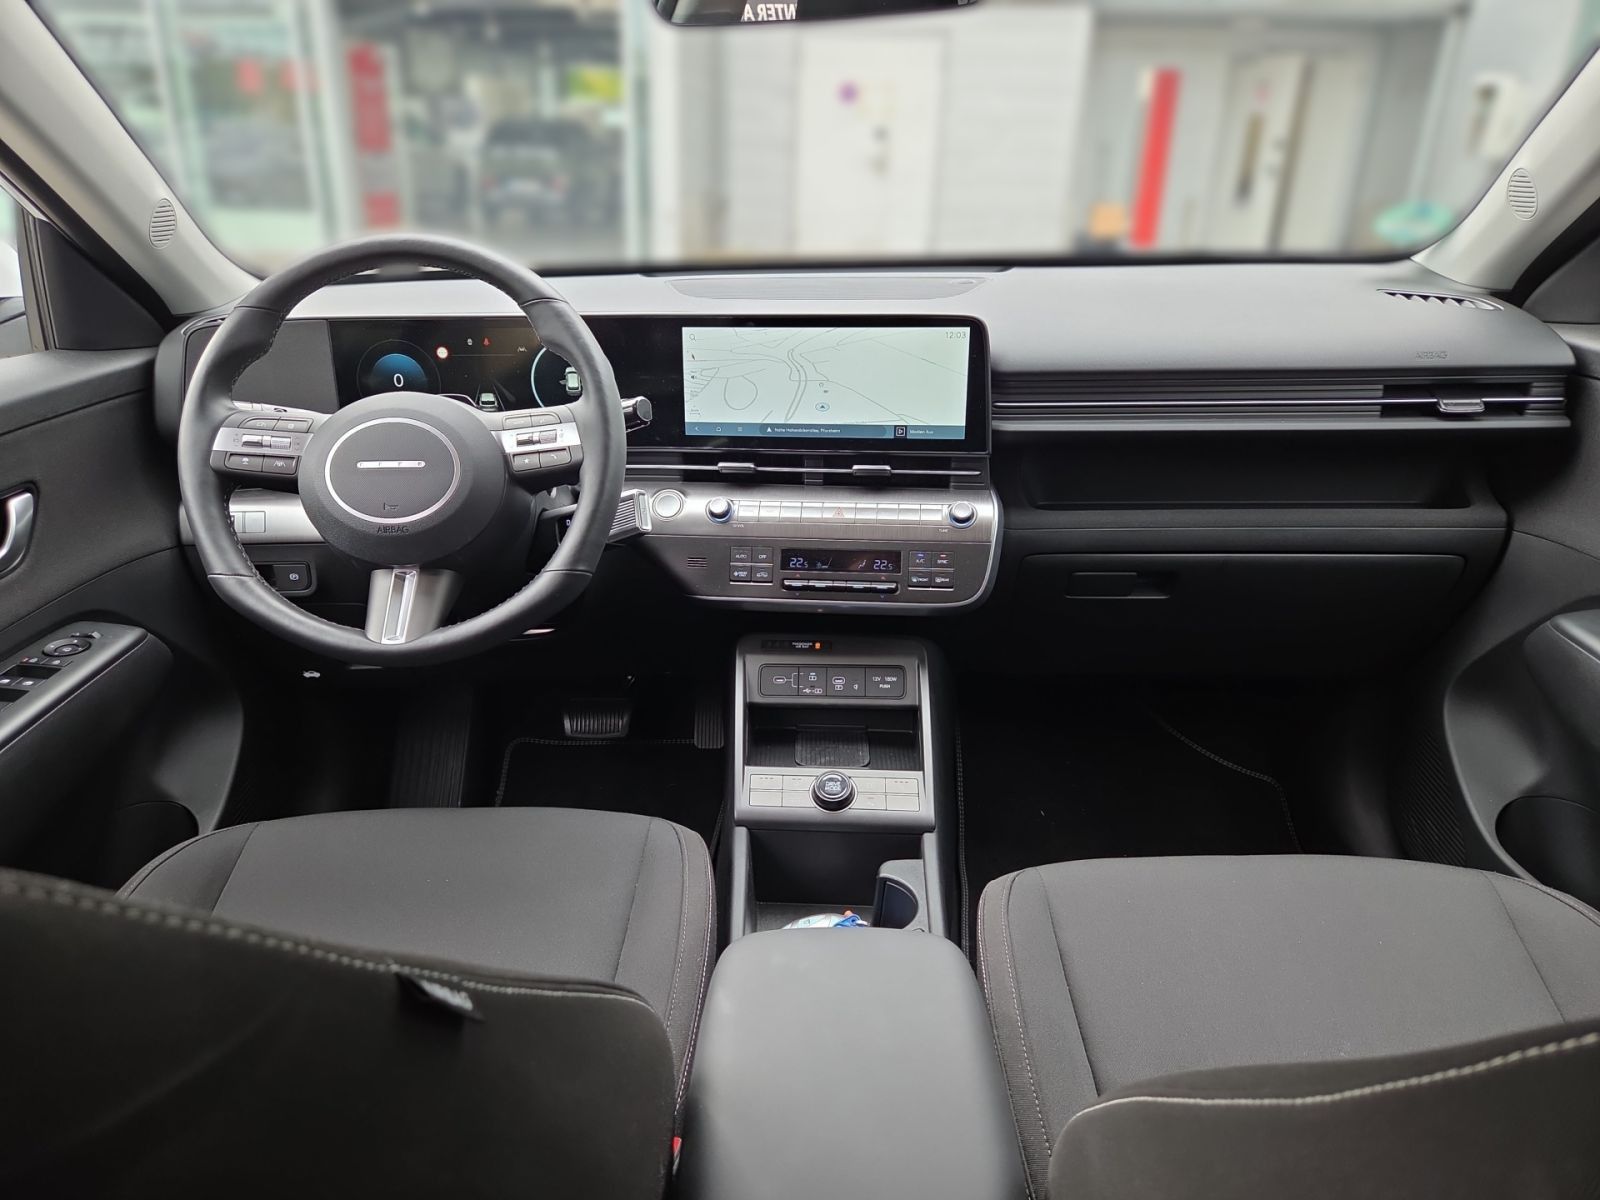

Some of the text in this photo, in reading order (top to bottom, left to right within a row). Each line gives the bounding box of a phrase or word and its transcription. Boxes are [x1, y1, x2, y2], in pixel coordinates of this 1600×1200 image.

[945, 331, 967, 339] 12:03
[1415, 351, 1448, 360] AIRBAG
[393, 373, 404, 388] 0
[377, 525, 410, 535] AIRBAG
